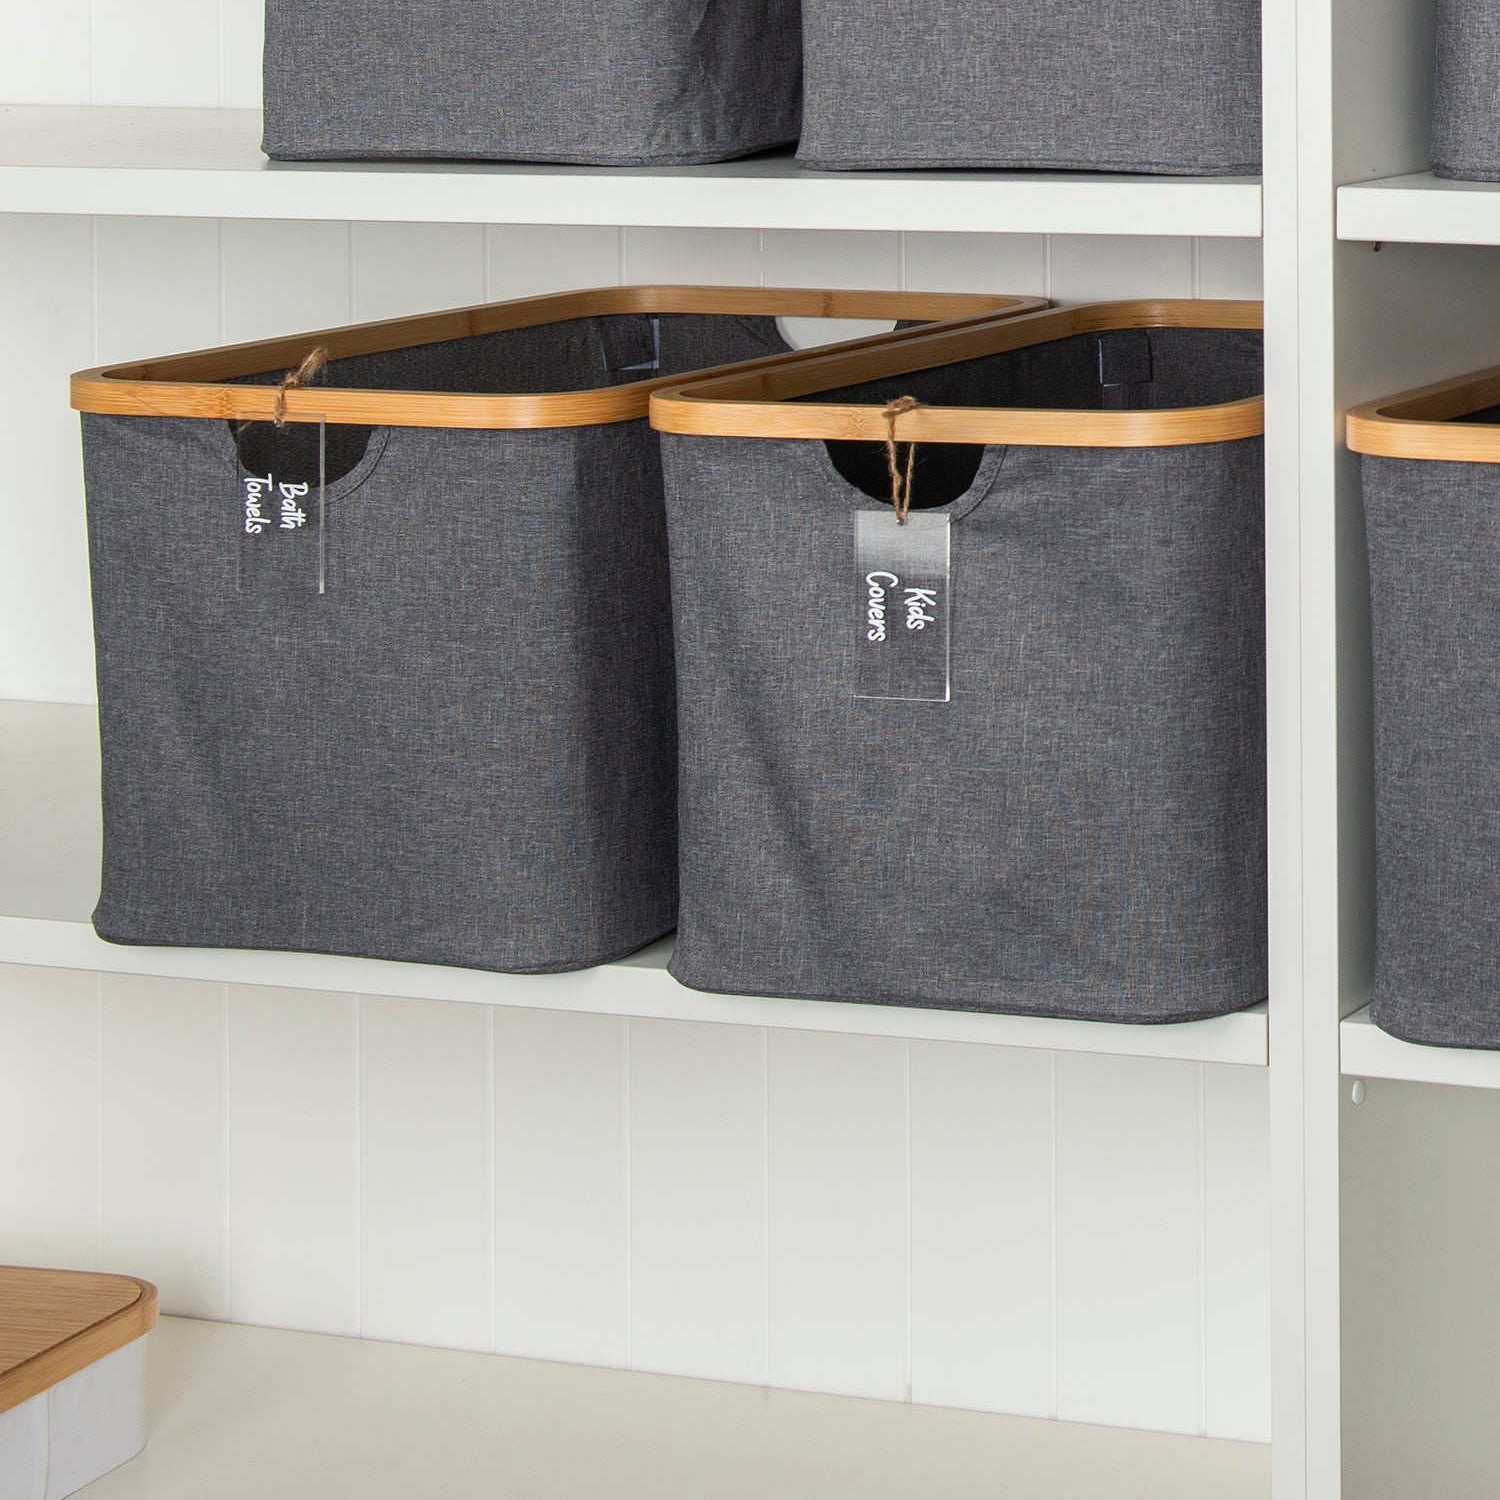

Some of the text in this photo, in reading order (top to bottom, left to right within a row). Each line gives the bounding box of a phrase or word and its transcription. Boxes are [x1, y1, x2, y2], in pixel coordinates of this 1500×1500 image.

[243, 472, 272, 534] Towels
[279, 481, 308, 529] Bath
[866, 571, 899, 642] Covers
[904, 588, 937, 630] Kids
